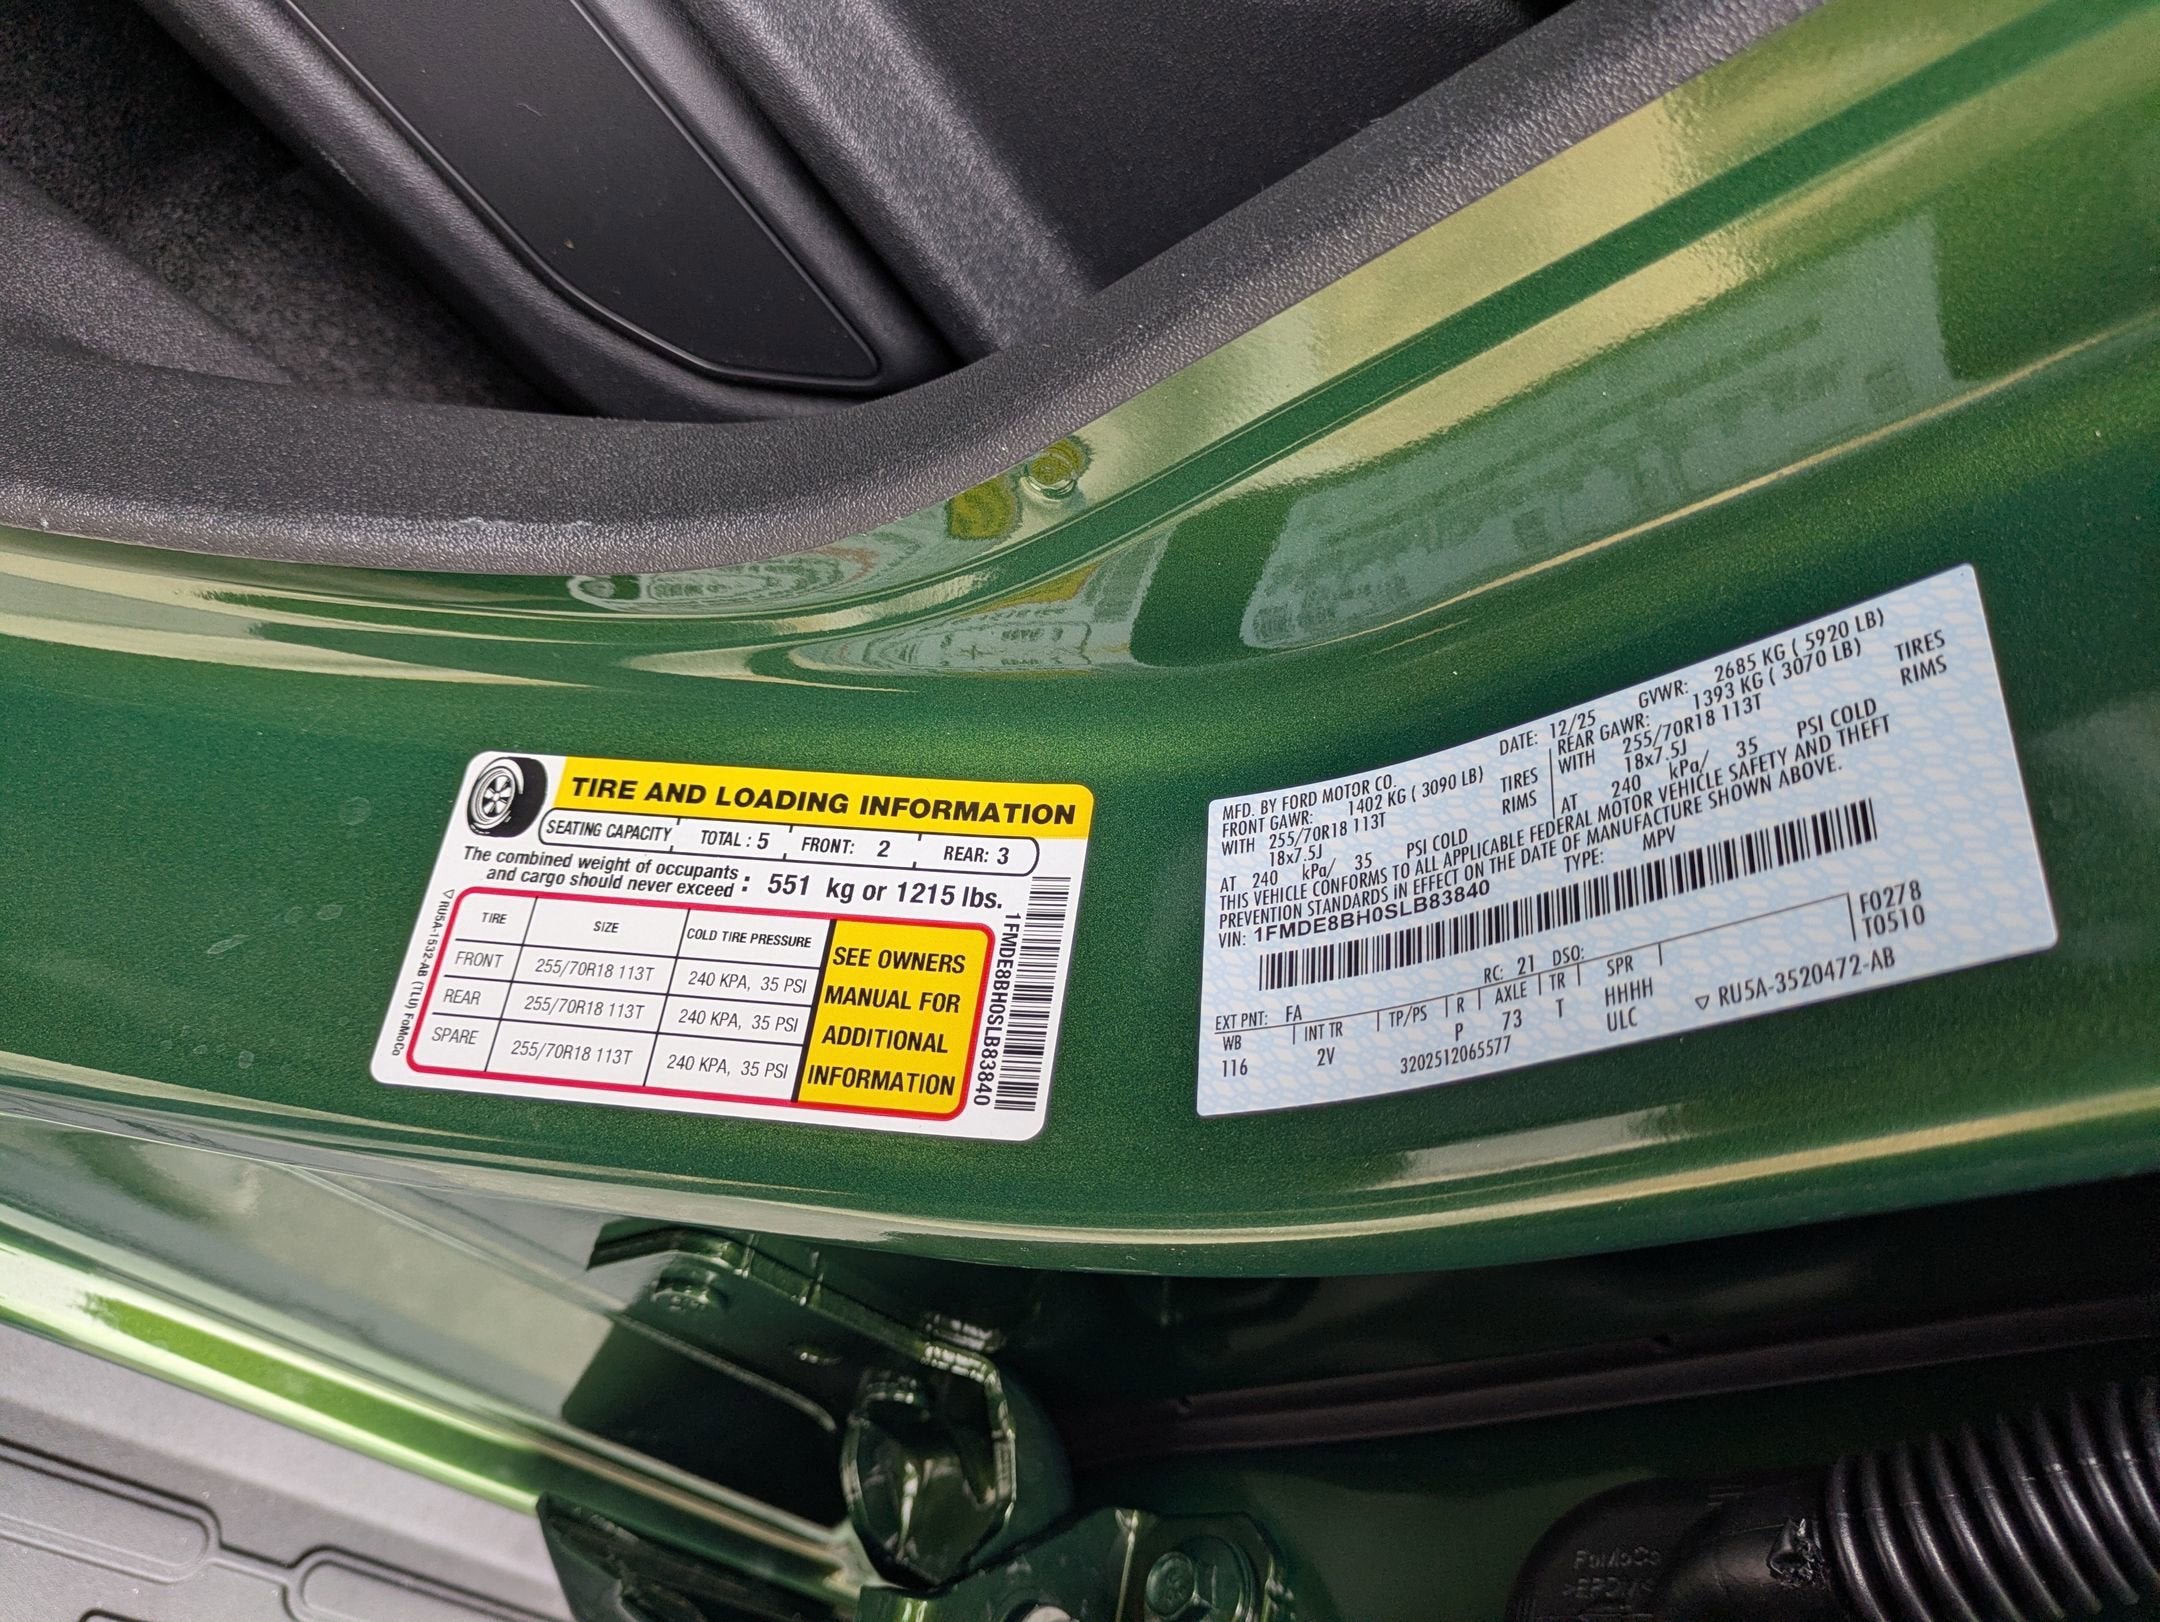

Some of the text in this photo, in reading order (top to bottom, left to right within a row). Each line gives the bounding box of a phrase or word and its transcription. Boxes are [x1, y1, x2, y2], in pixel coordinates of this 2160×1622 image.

[1639, 620, 1851, 709] GVWR: 2685 KG 5920
[1899, 653, 1947, 687] RIMS
[1500, 709, 1596, 756] DATE: 12/25
[1558, 649, 1828, 755] REAR GAWR: 1393 KG 3070
[1558, 629, 1946, 775] WITH 255/70R18 113T TIRES
[1561, 697, 1878, 815] AT 240 35 PSI COLD
[572, 776, 1075, 825] TIRE AND LOADING INFORMATION
[1220, 714, 1891, 912] THIS VEHICLE CONFORMS TO ALL APPLICABLE FEDERAL MOTOR VEHICLE SAFETY AND THEFT
[1222, 774, 1397, 821] MFD. BY FORD MOTOR CO.
[1222, 775, 1457, 838] FRONT GAWR: 1402 KG 3090
[1222, 767, 1539, 856] WITH 255/70R18 113T TIRES
[546, 819, 1009, 865] SEATING CAPACITY 5 FRONT: 2 REAR: 3
[1219, 754, 1843, 930] PREVENTION STANDARDS IN EFFECT ON THE DATE OF MANUFACTURE SHOWN ABOVE.
[1270, 790, 1537, 868] 18x7.5J RIMS
[1563, 825, 1676, 874] TYPE: MPV
[463, 845, 739, 880] The combined weight of occupants
[486, 866, 734, 898] and cargo should never exceed
[1220, 827, 1468, 894] AT 240 35 PSI COLD
[768, 873, 1002, 910] 551 kg or 1215 lbs.
[1218, 879, 1491, 949] VIN: 1FMDE8BH0SLB83840
[481, 912, 812, 948] TIRE SIZE COLD TIRE PRESSURE
[832, 946, 966, 974] SEE OWNERS
[391, 900, 450, 1057] RU5A-1532-AB (TLU) FoMoCo
[454, 951, 807, 994] FRONT 255/70R18 113T 240 35 PSI
[824, 985, 961, 1014] MANUAL FOR
[1215, 945, 1584, 1031] EXT PNT: FA RC: 21 DSO:
[1223, 955, 1634, 1051] WB INT TR TP/PS AXLE TR SPR
[1717, 946, 1895, 1007] RU5A-3520472-AB
[443, 988, 799, 1033] REAR 255/70R18 113T 240 35 PSI
[822, 1024, 949, 1054] ADDITIONAL
[973, 911, 1021, 1107] 1FMDE8BH0SLB83840
[1222, 977, 1654, 1078] 116 2V 73 HHHH
[431, 1027, 788, 1080] SPARE 255/70R18 113T 240 35 PSI
[1400, 1007, 1638, 1075] 3202512065577 ULC
[807, 1063, 956, 1096] INFORMATION
